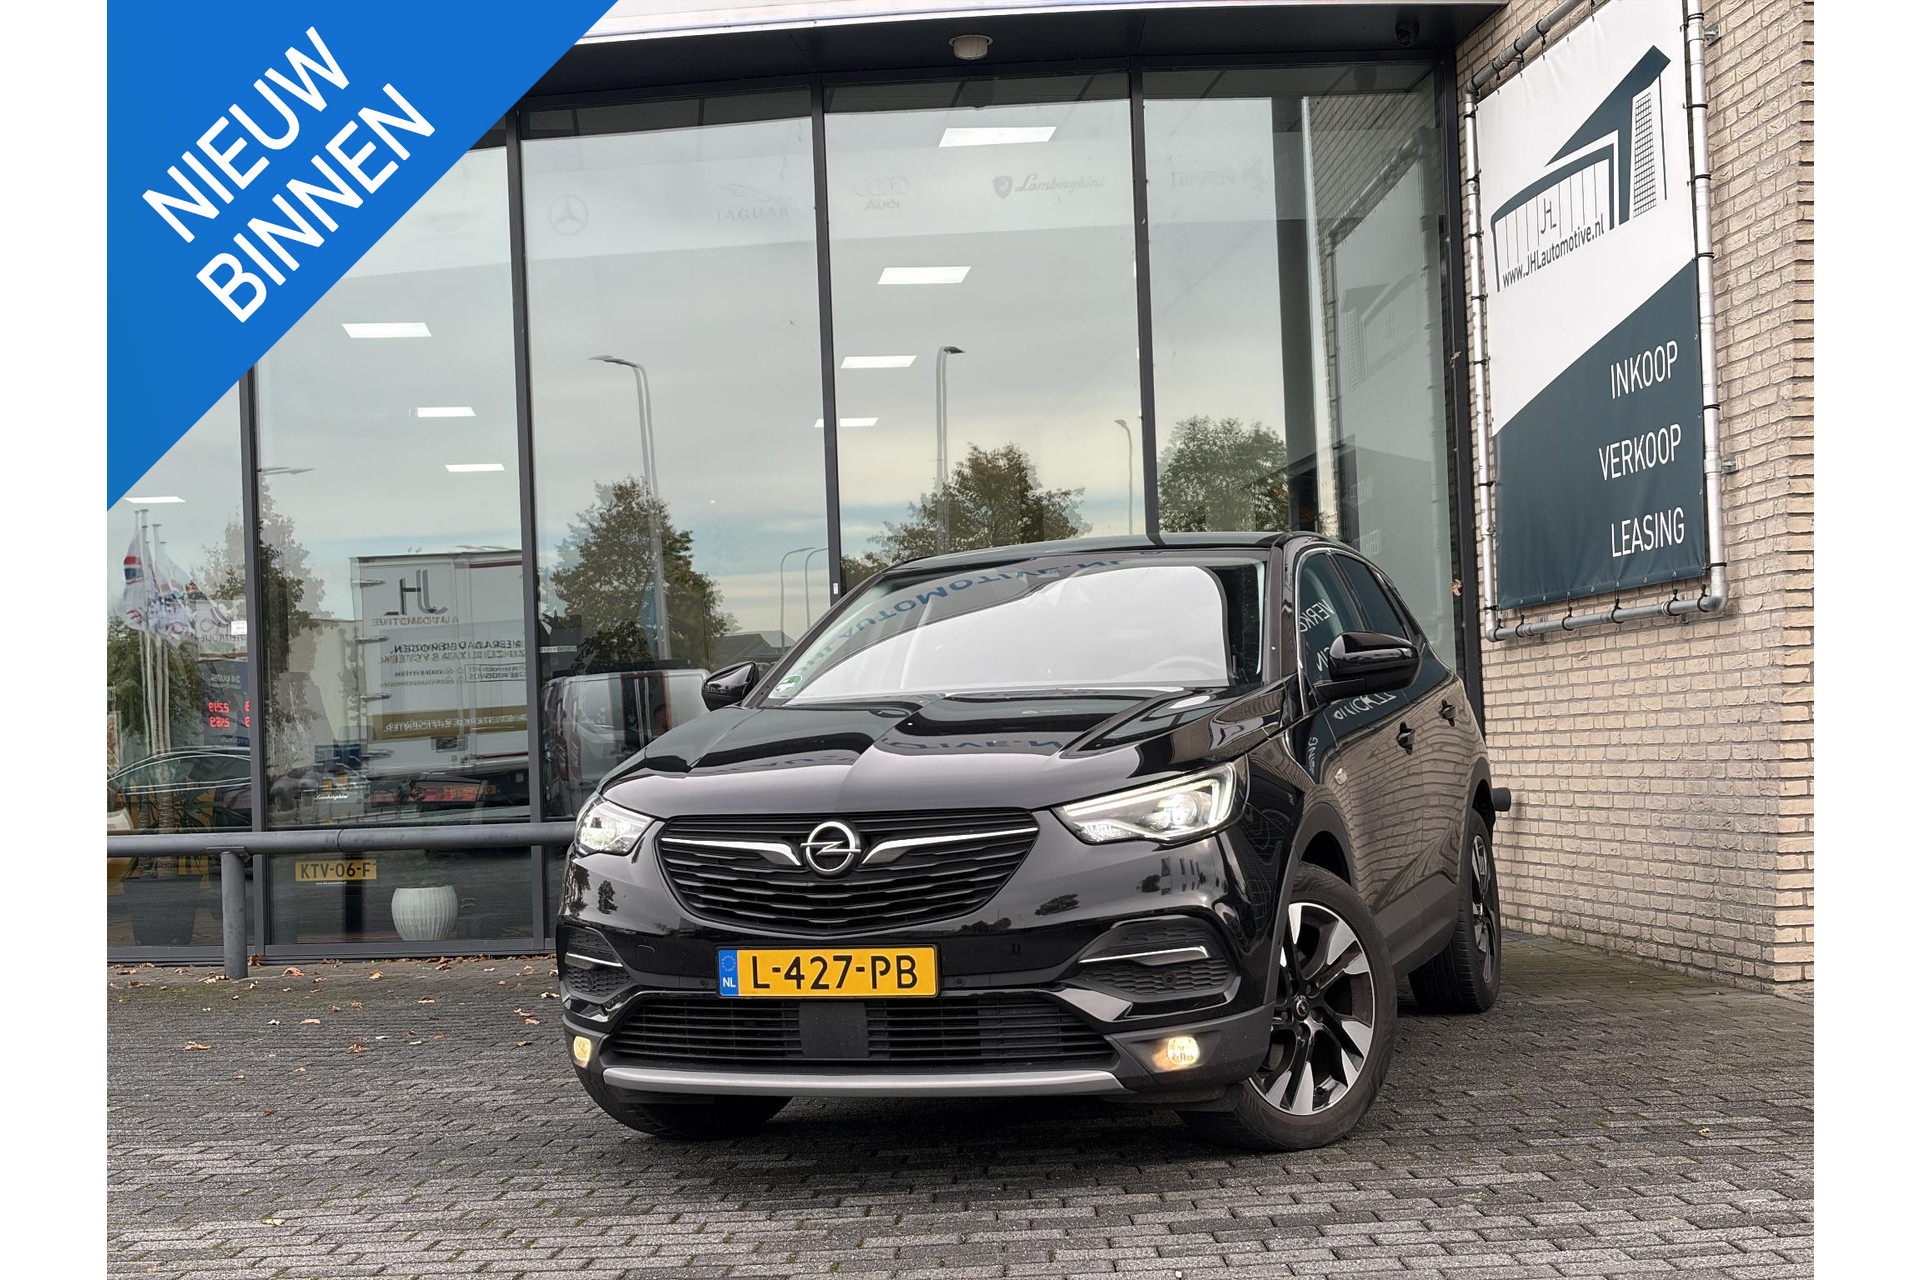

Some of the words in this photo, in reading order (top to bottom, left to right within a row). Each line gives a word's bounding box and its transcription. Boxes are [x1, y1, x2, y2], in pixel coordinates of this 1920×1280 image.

[1014, 172, 1108, 193] Lamborghini
[1540, 198, 1557, 235] JHL
[1502, 213, 1605, 288] www.JHLautomotive.nl
[1610, 340, 1679, 400] INKOOP
[1598, 424, 1682, 482] VERKOOP
[1611, 507, 1685, 558] LEASING
[722, 977, 737, 988] NL
[751, 954, 918, 990] L-427-PB
